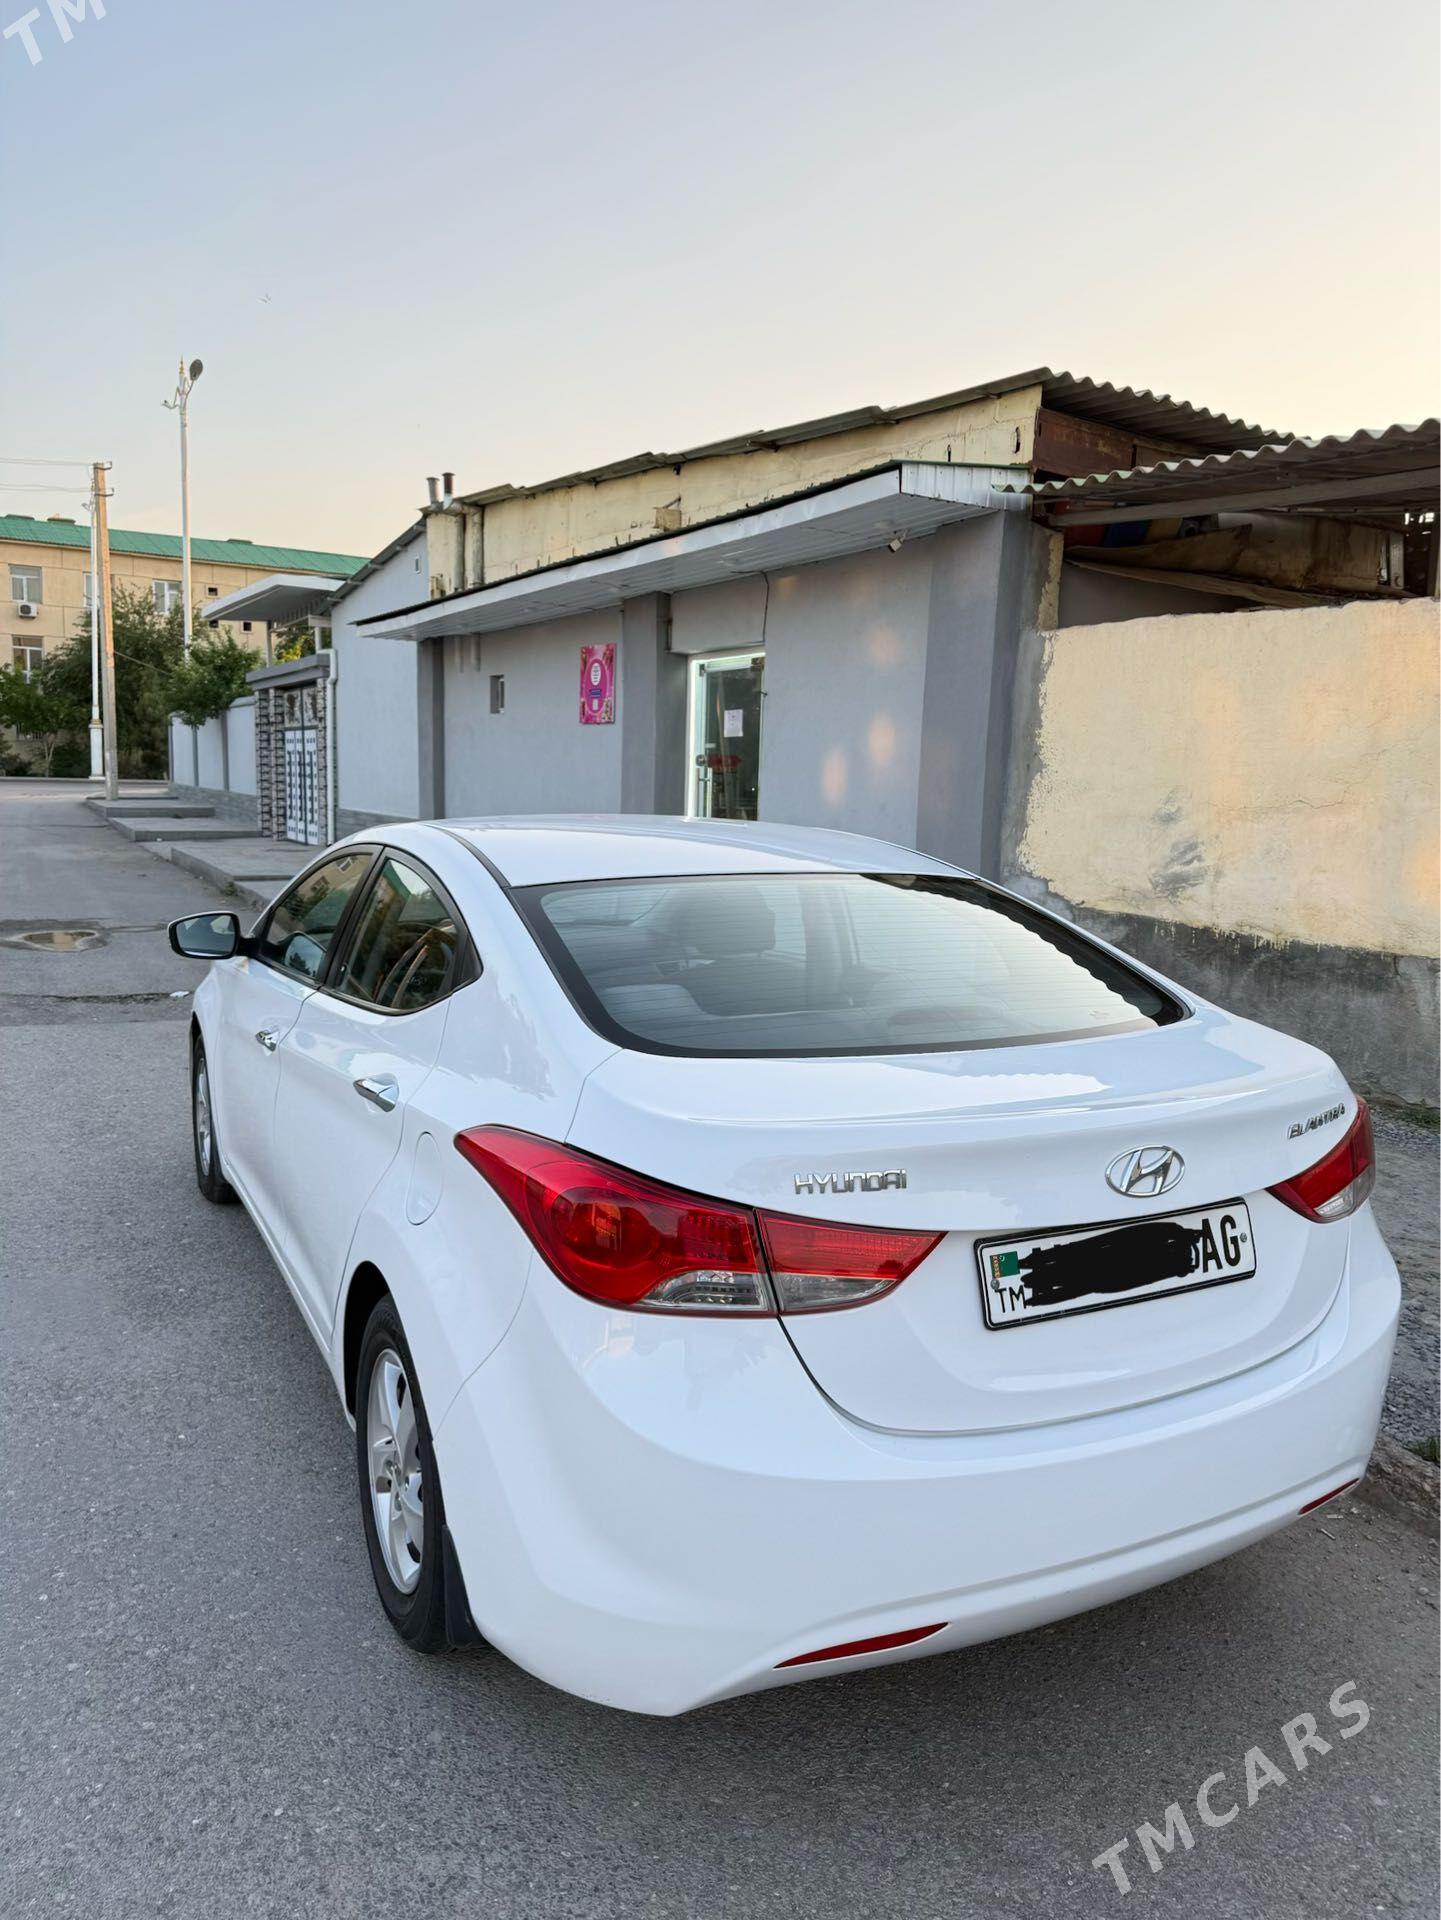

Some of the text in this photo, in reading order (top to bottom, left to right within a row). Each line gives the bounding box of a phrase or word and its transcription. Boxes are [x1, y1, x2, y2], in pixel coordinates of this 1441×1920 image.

[1287, 1102, 1345, 1139] ELANTRA
[794, 1168, 907, 1195] HYUNDAI
[994, 1284, 1027, 1314] TM
